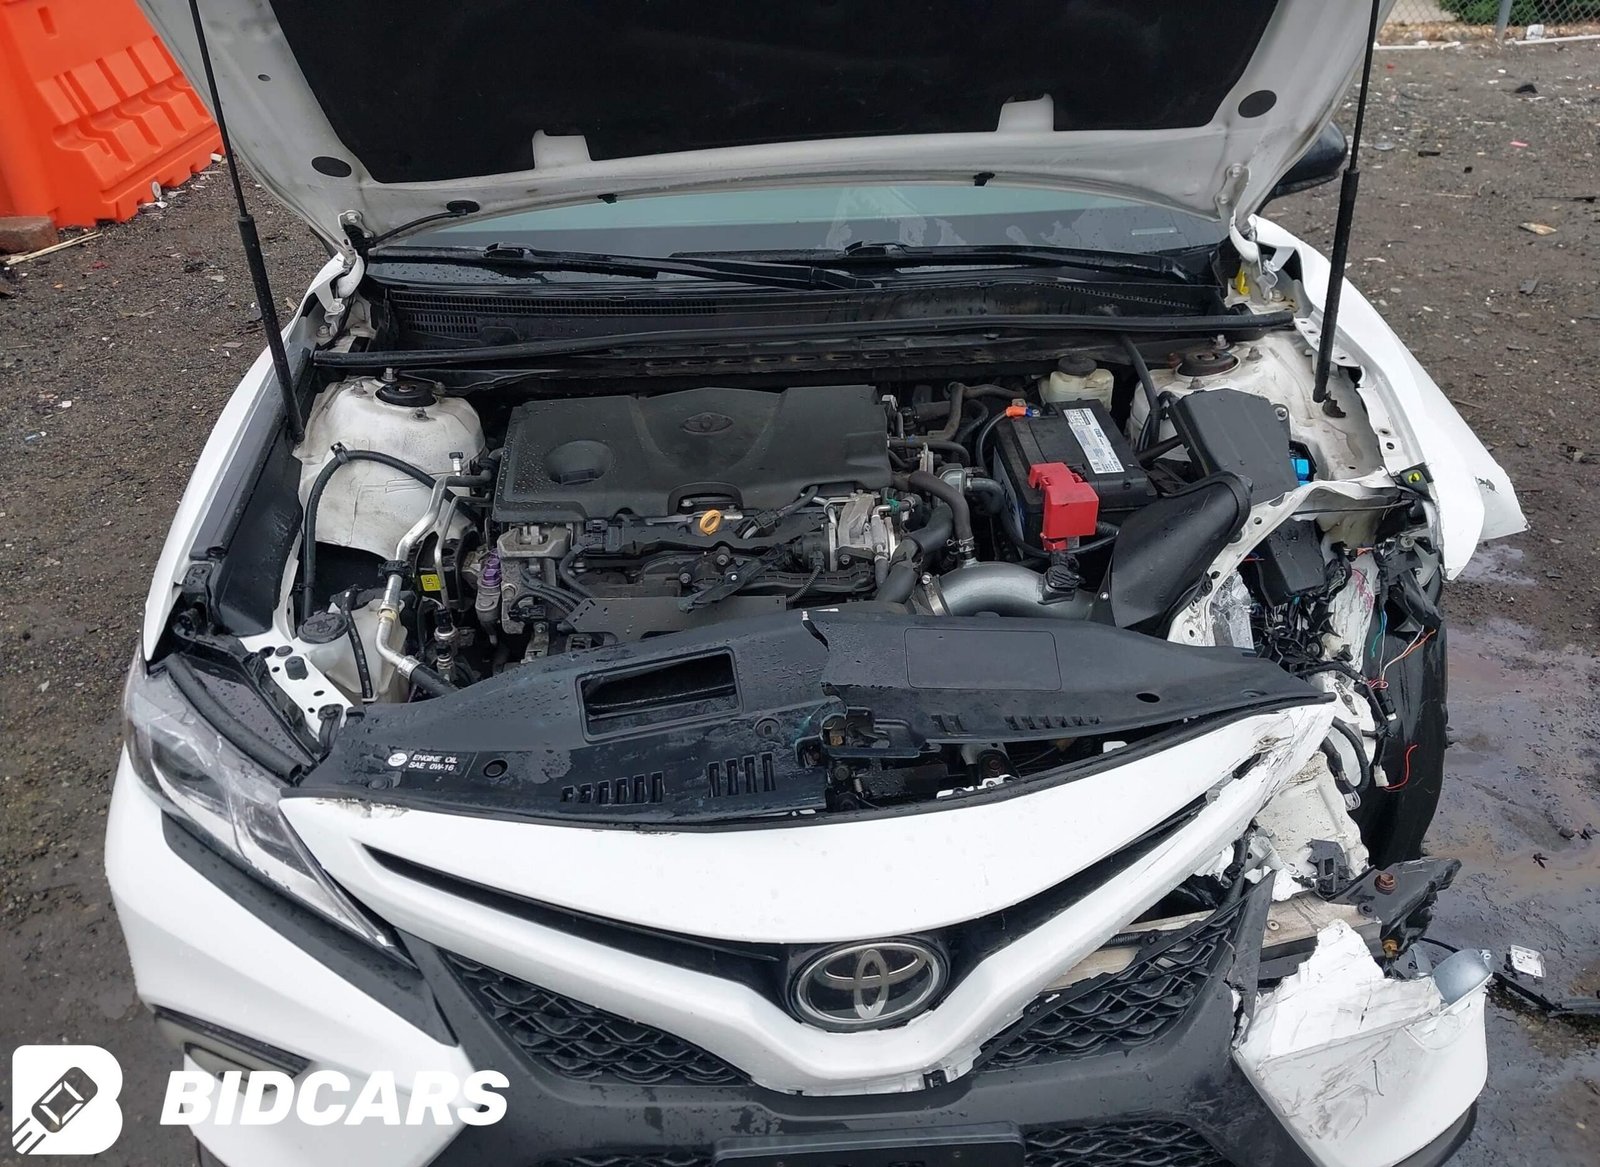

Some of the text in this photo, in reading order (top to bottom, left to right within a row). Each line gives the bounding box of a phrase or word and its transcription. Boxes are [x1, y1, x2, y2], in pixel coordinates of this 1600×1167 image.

[412, 754, 458, 764] ENGINE OIL
[408, 761, 455, 771] SAE 0W-16
